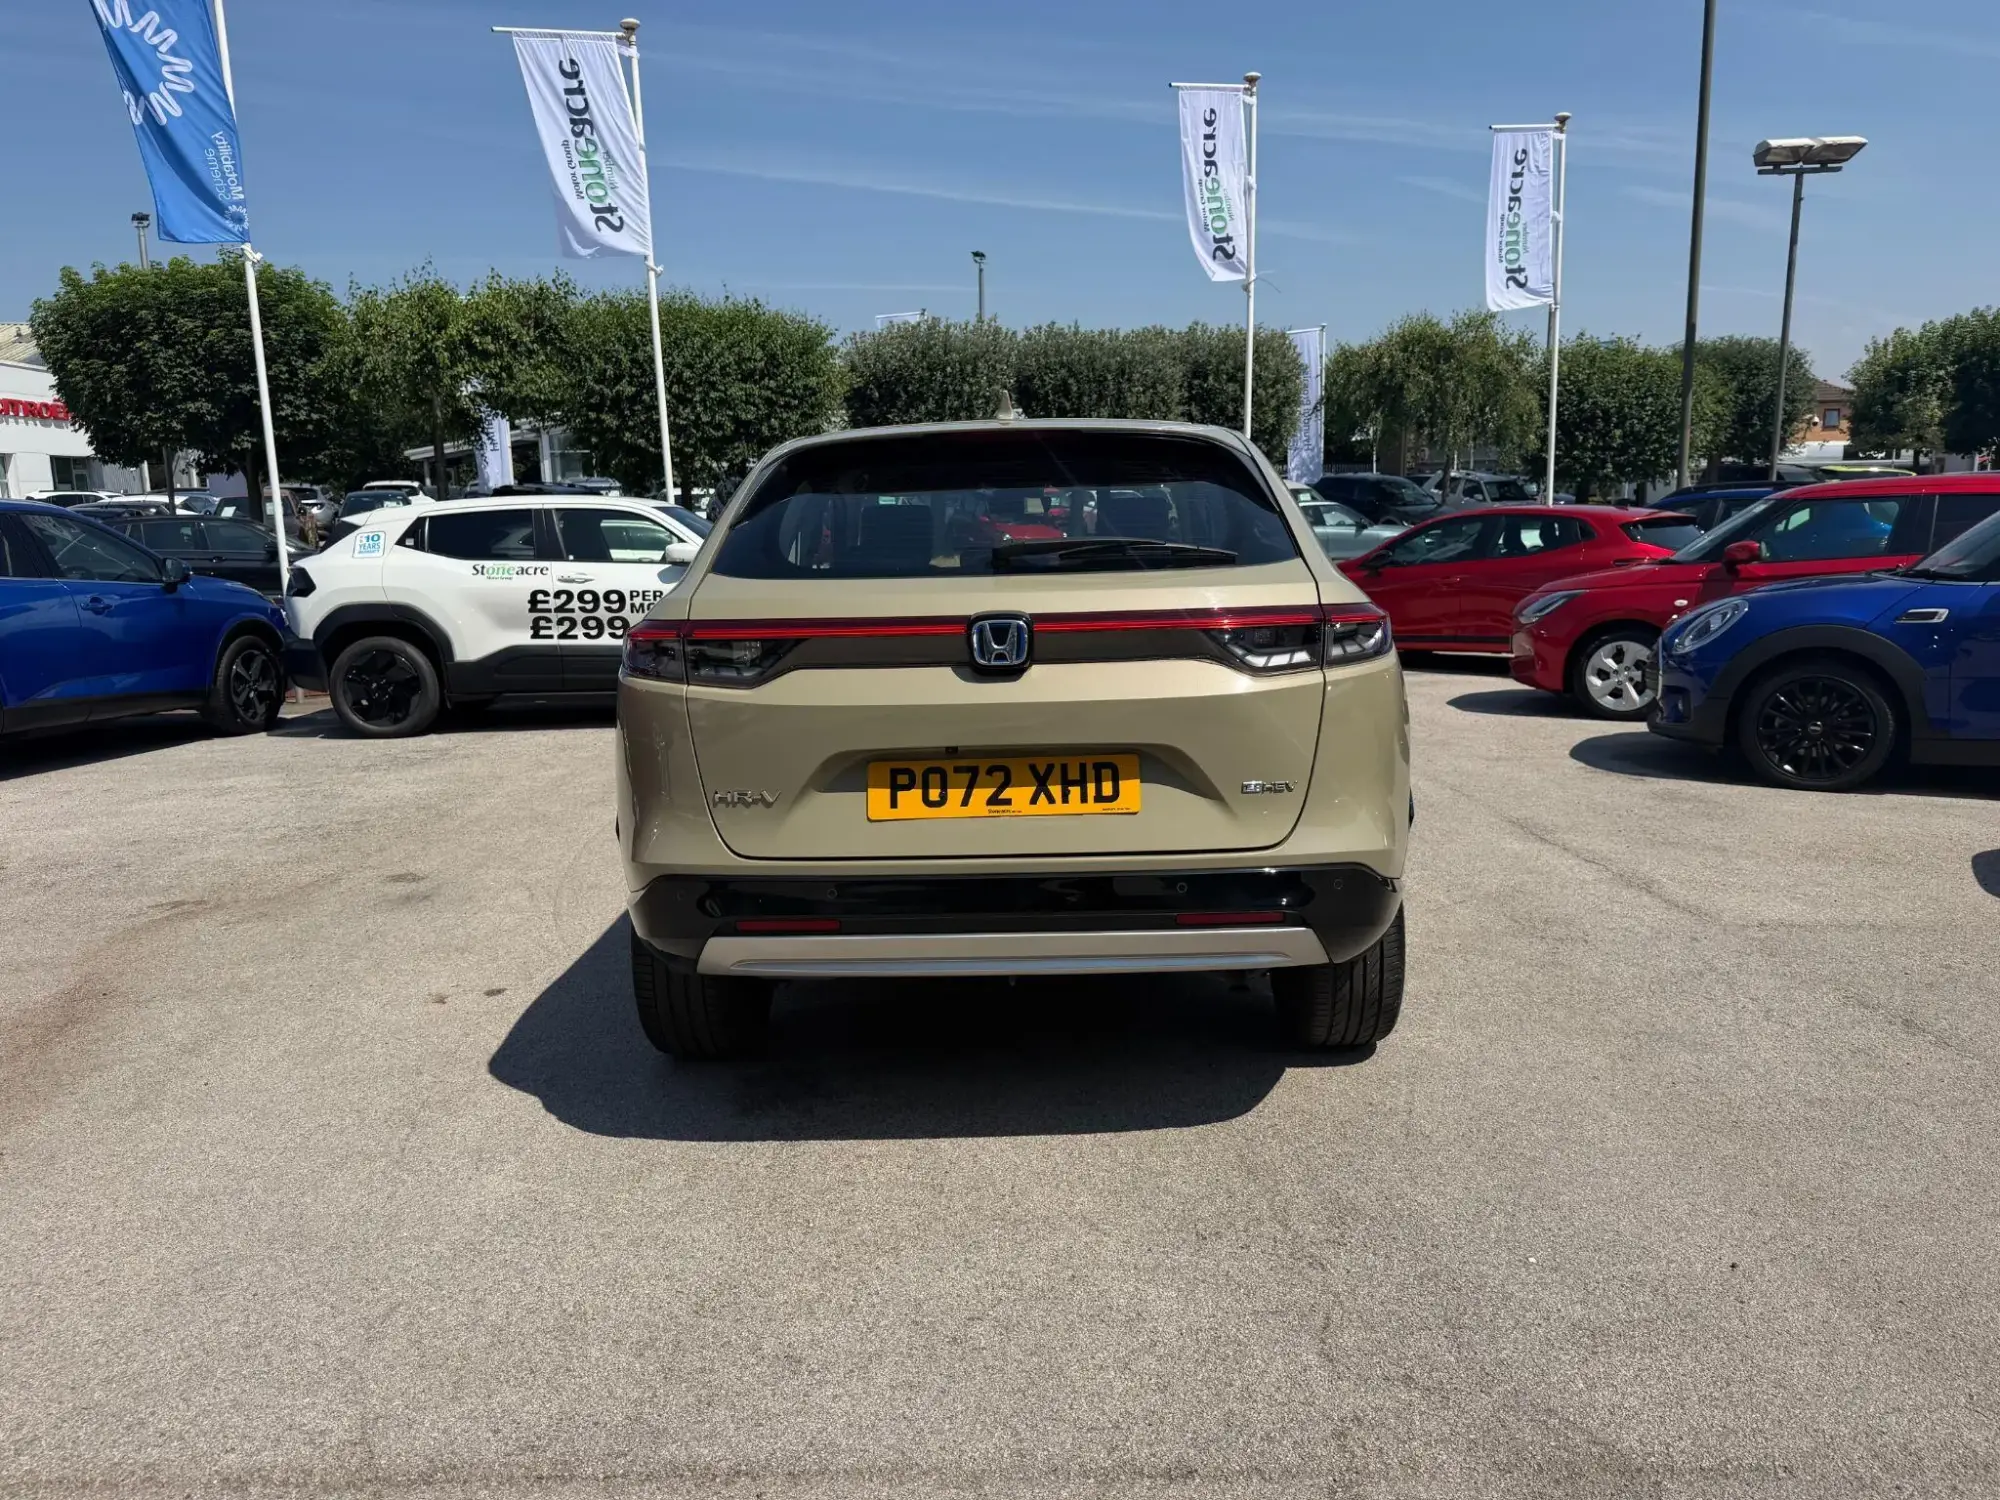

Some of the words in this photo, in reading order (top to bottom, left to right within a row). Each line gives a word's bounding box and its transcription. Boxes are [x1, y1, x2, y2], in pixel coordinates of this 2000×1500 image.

[364, 534, 381, 543] 10
[472, 563, 549, 576] Stoneacre
[528, 590, 627, 613] £299
[630, 590, 664, 601] PER
[530, 616, 630, 640] £299
[889, 765, 1012, 809] PO72
[1028, 762, 1120, 806] XHD
[713, 789, 781, 808] HR-V
